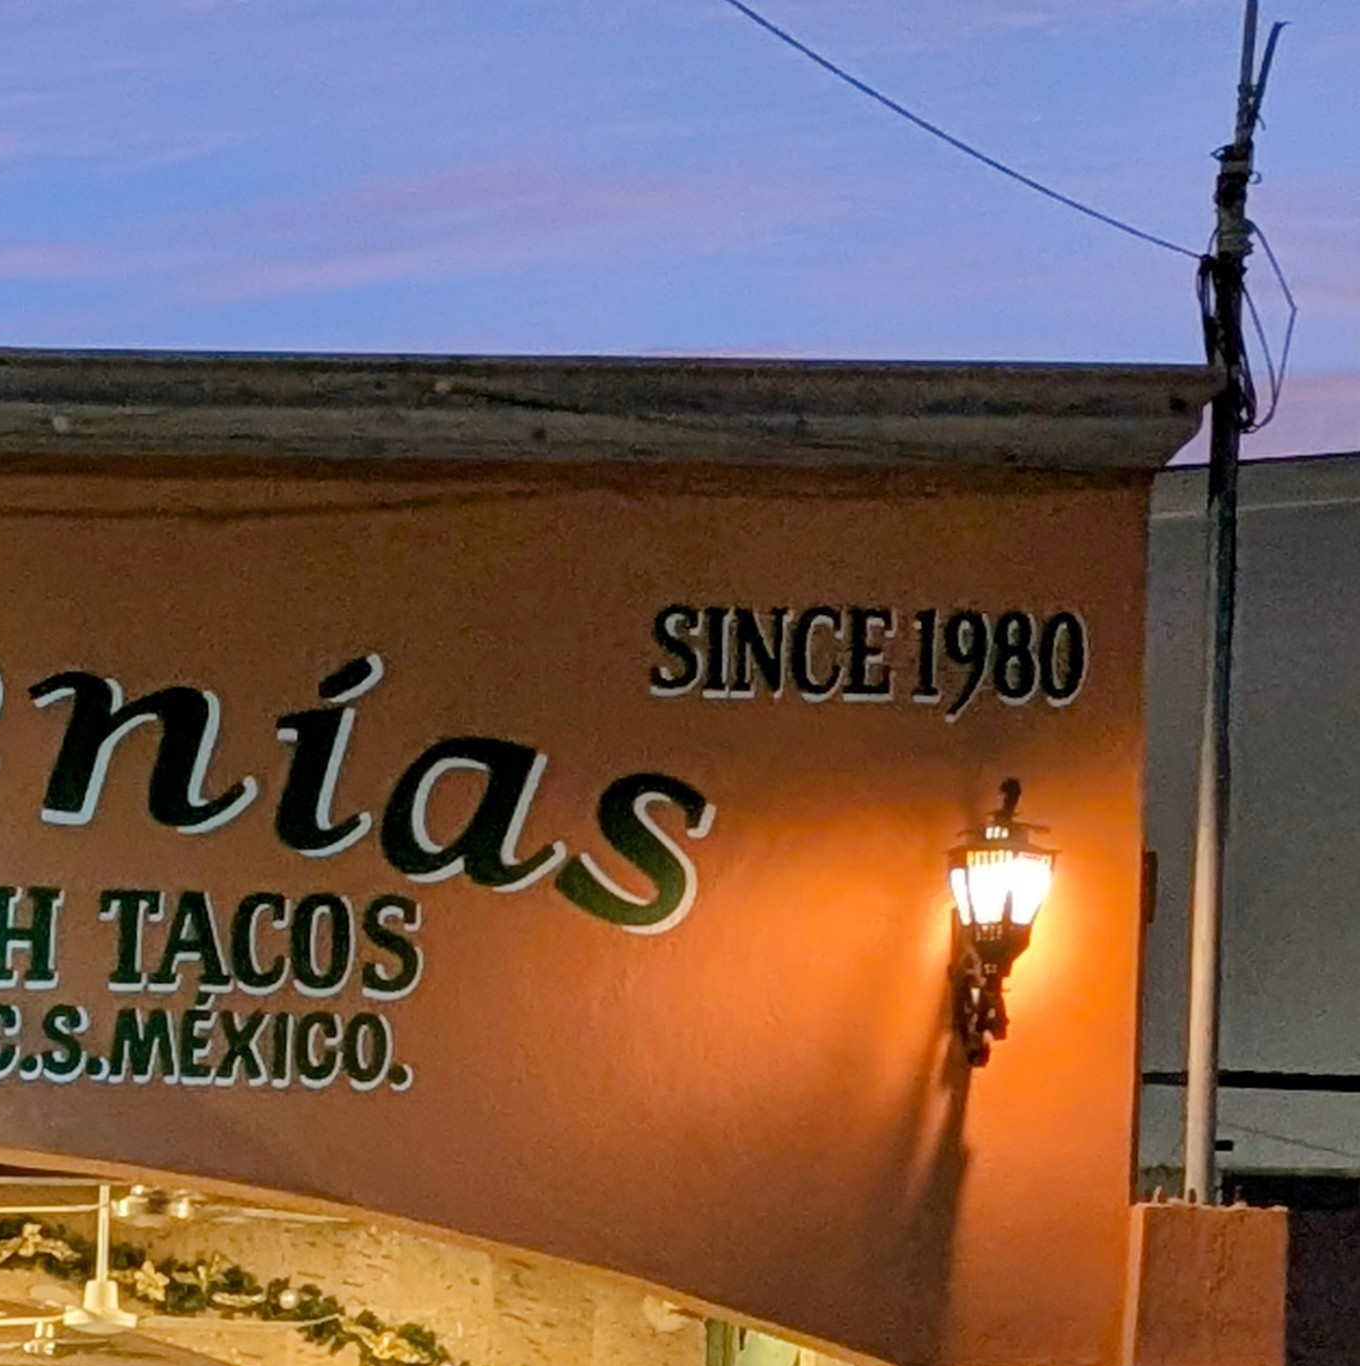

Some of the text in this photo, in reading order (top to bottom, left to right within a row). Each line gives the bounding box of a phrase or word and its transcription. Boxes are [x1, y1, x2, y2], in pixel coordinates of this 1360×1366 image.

[650, 604, 1089, 723] SINCE 1980
[98, 889, 425, 1000] TACOS
